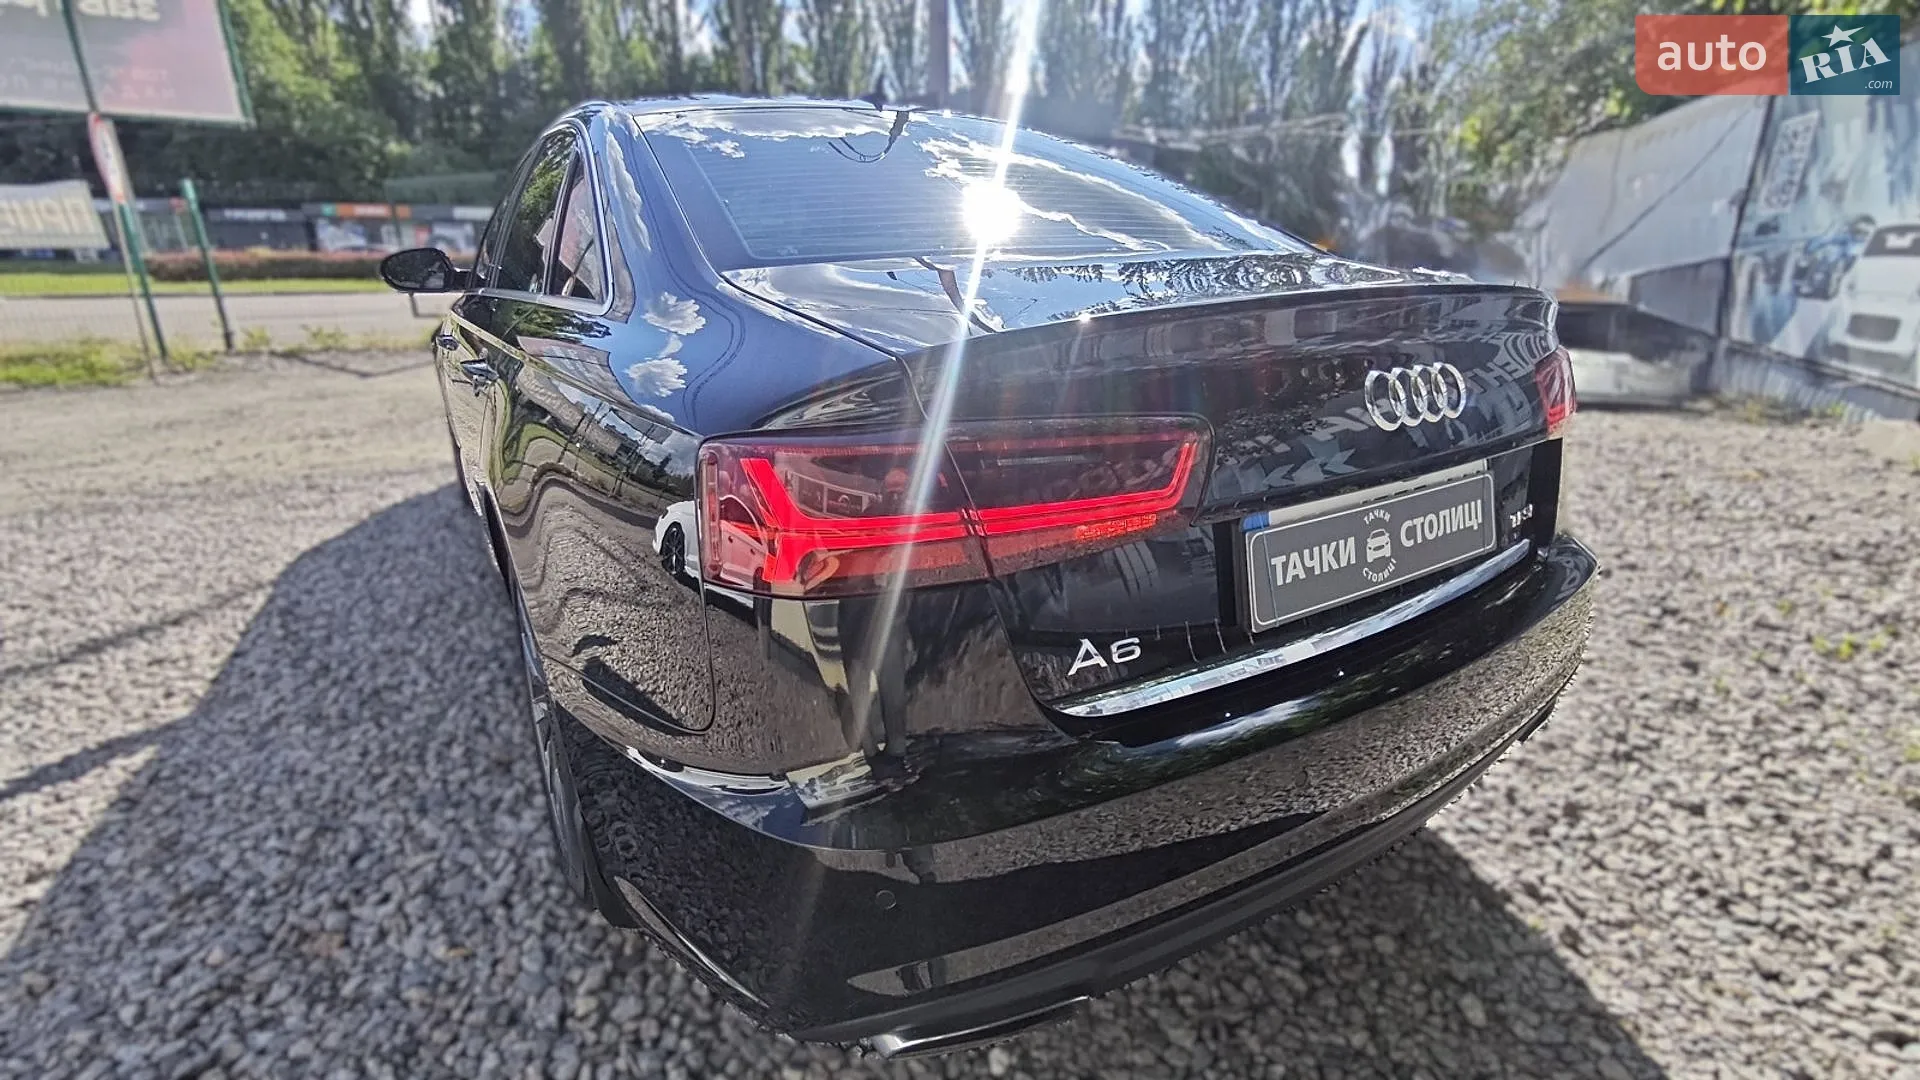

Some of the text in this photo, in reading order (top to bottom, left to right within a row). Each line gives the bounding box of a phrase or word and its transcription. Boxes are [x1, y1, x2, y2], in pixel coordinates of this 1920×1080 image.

[1363, 508, 1391, 525] ТАЧКИ
[1271, 500, 1482, 586] ТАЧКИ СТОЛИЦІ
[1363, 557, 1397, 583] СТОЛИЦІ
[1067, 637, 1141, 676] A6
